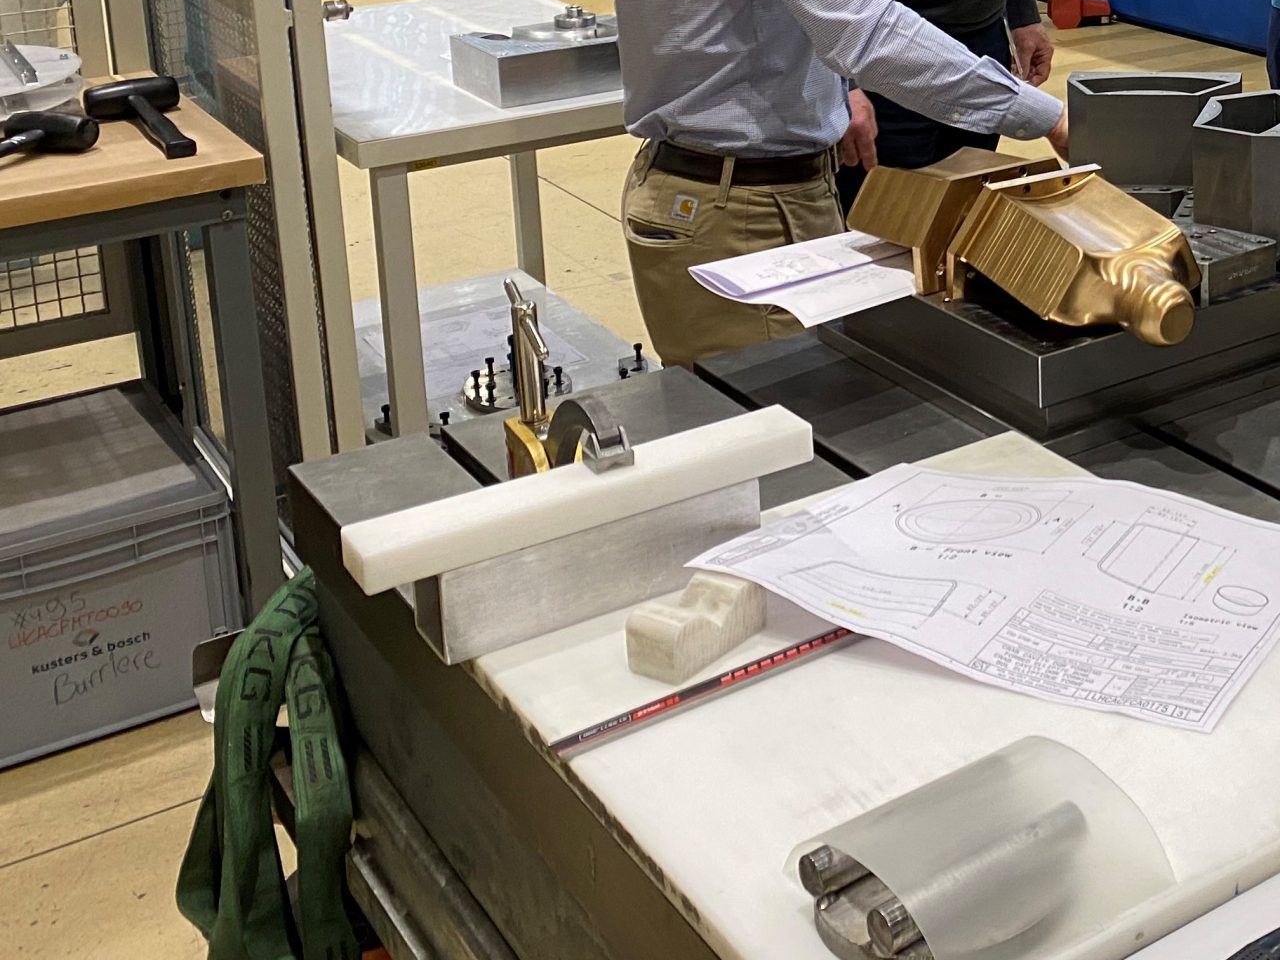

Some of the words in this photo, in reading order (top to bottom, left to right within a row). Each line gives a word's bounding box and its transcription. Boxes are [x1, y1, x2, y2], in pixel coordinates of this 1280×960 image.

[31, 650, 88, 674] kusters
[91, 645, 103, 656] &
[107, 631, 151, 652] bosch
